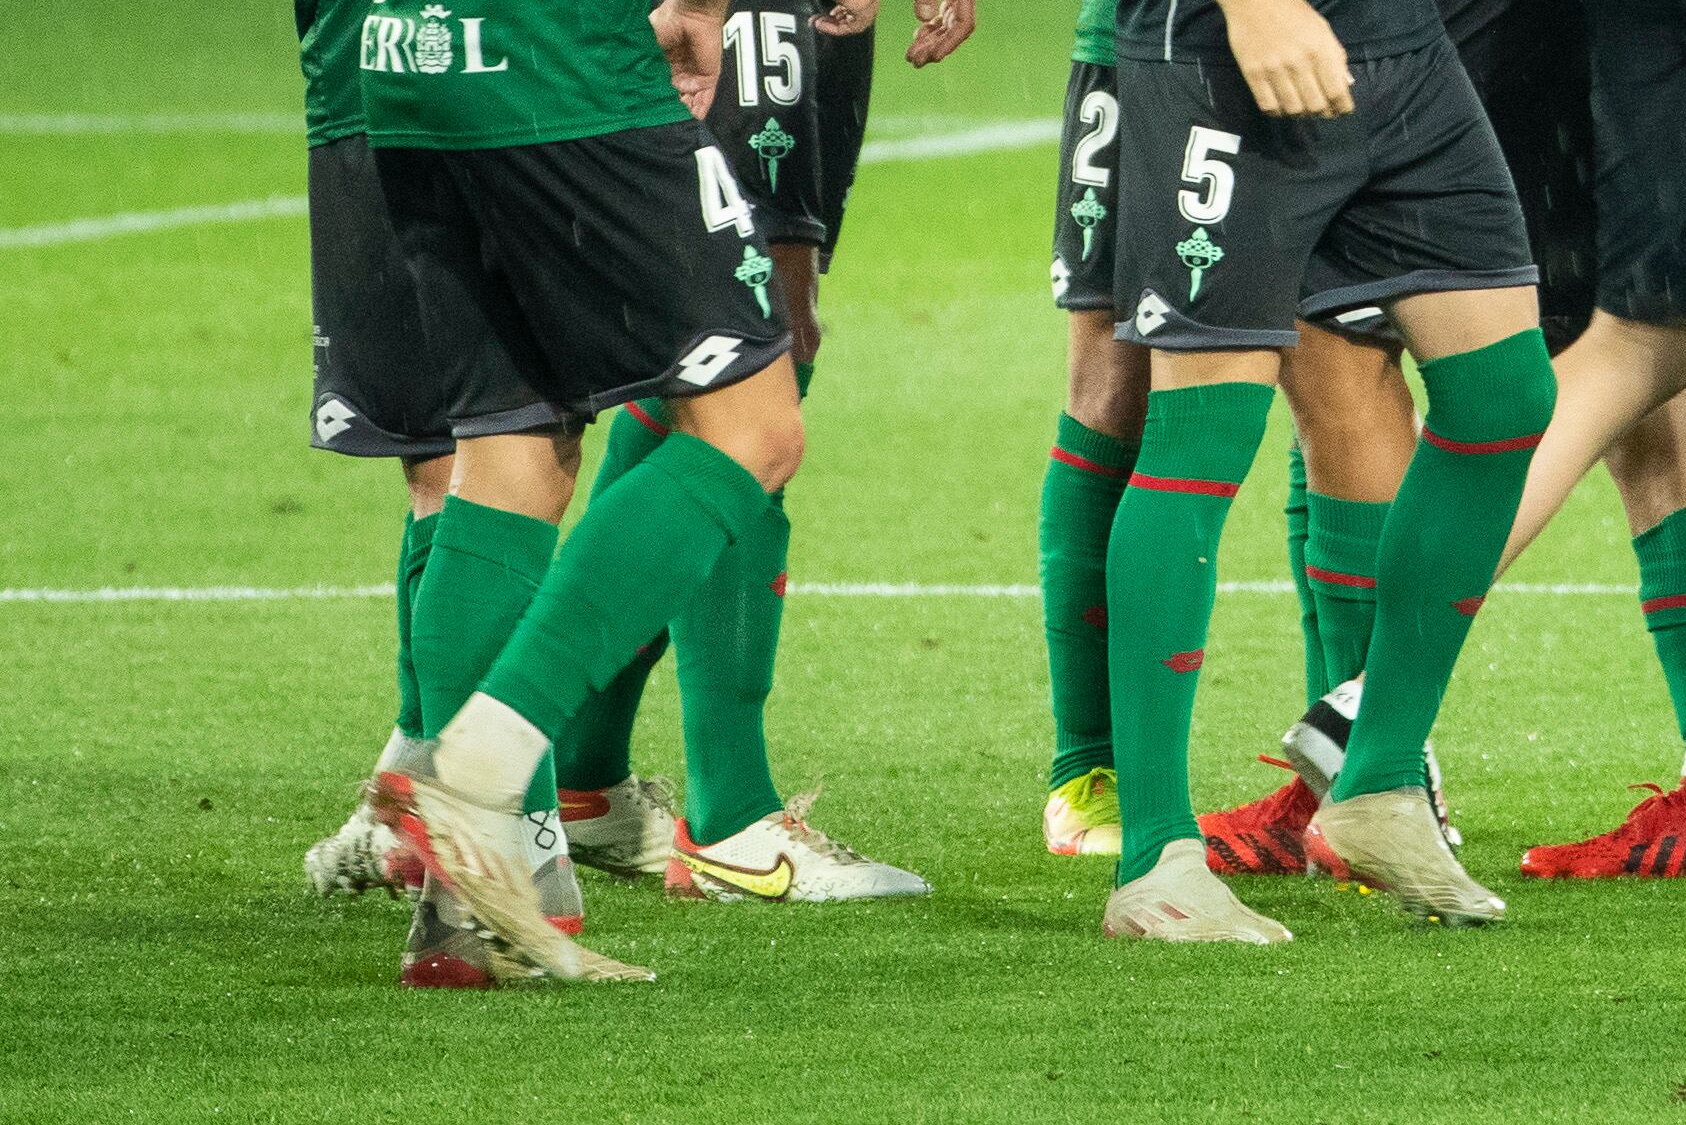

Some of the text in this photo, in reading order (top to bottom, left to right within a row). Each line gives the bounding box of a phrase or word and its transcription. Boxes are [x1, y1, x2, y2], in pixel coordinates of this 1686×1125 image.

[723, 11, 802, 107] 15
[695, 146, 755, 237] 4
[1177, 125, 1241, 226] 5
